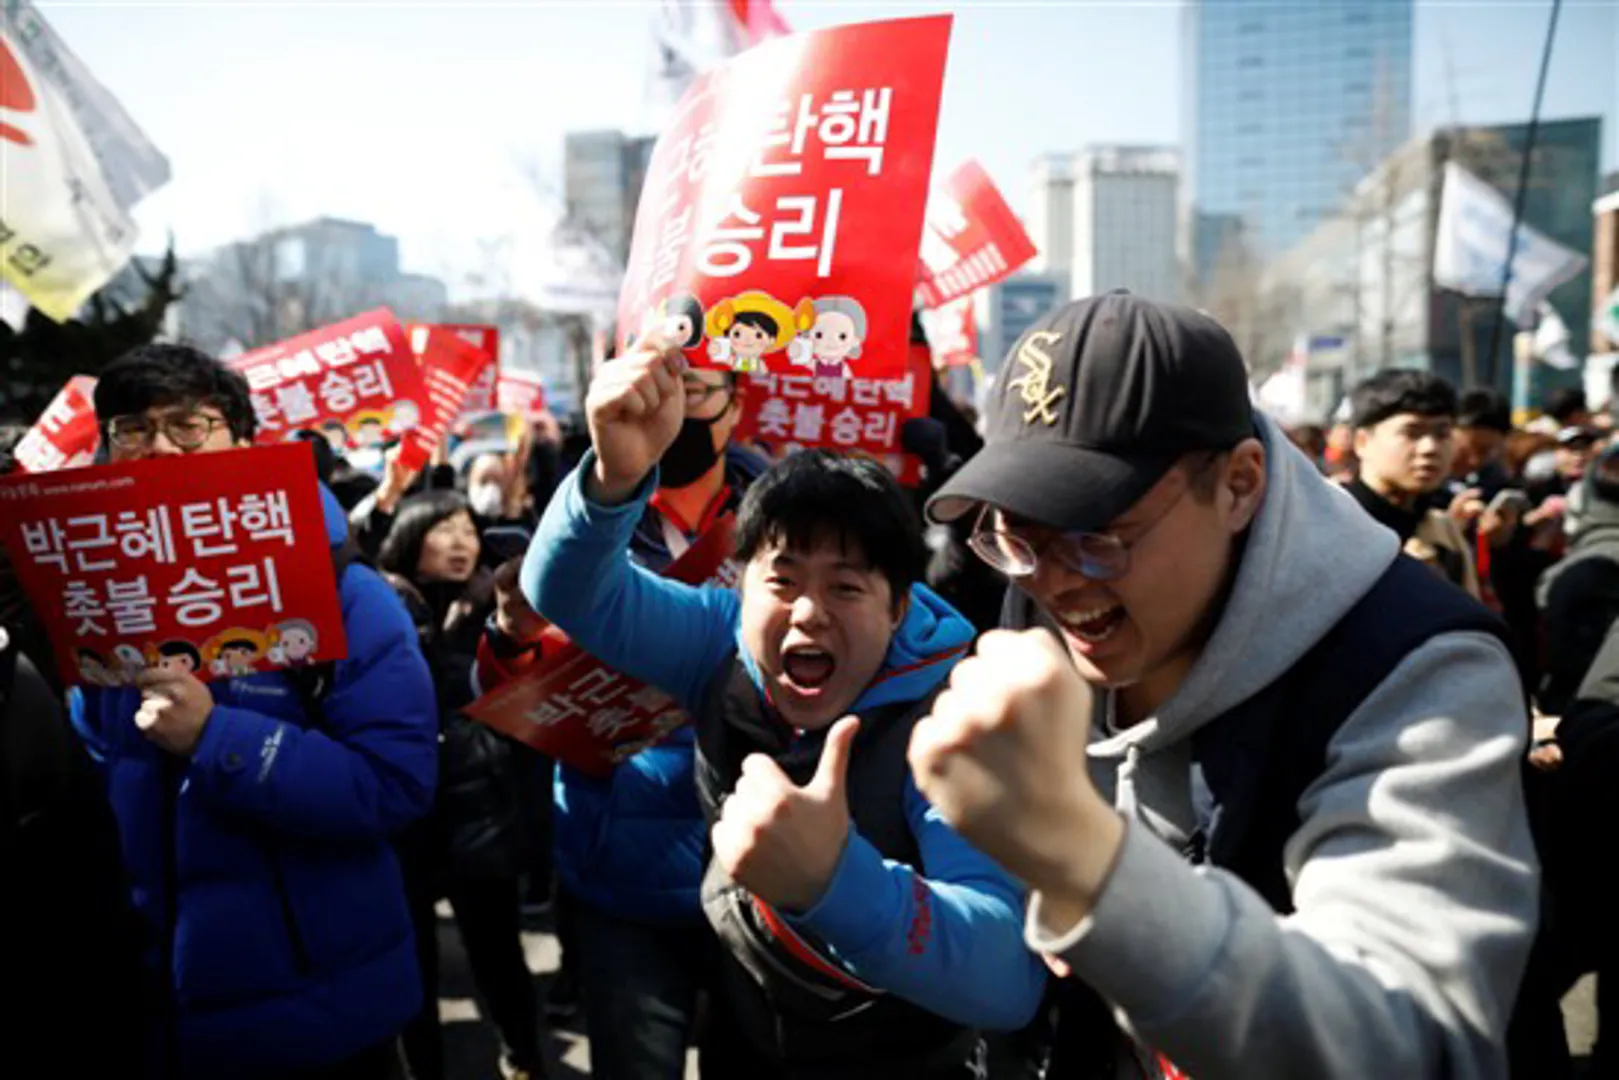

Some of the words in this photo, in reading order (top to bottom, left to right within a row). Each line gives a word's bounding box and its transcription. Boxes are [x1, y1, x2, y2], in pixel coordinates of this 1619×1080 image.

[752, 87, 893, 176] 탄핵
[694, 188, 843, 278] 승리
[319, 358, 394, 413] 승리
[830, 405, 898, 449] 승리
[20, 504, 177, 575] 박근혜
[180, 489, 296, 558] 탄핵
[61, 573, 157, 637] 촛불
[167, 556, 283, 627] 승리
